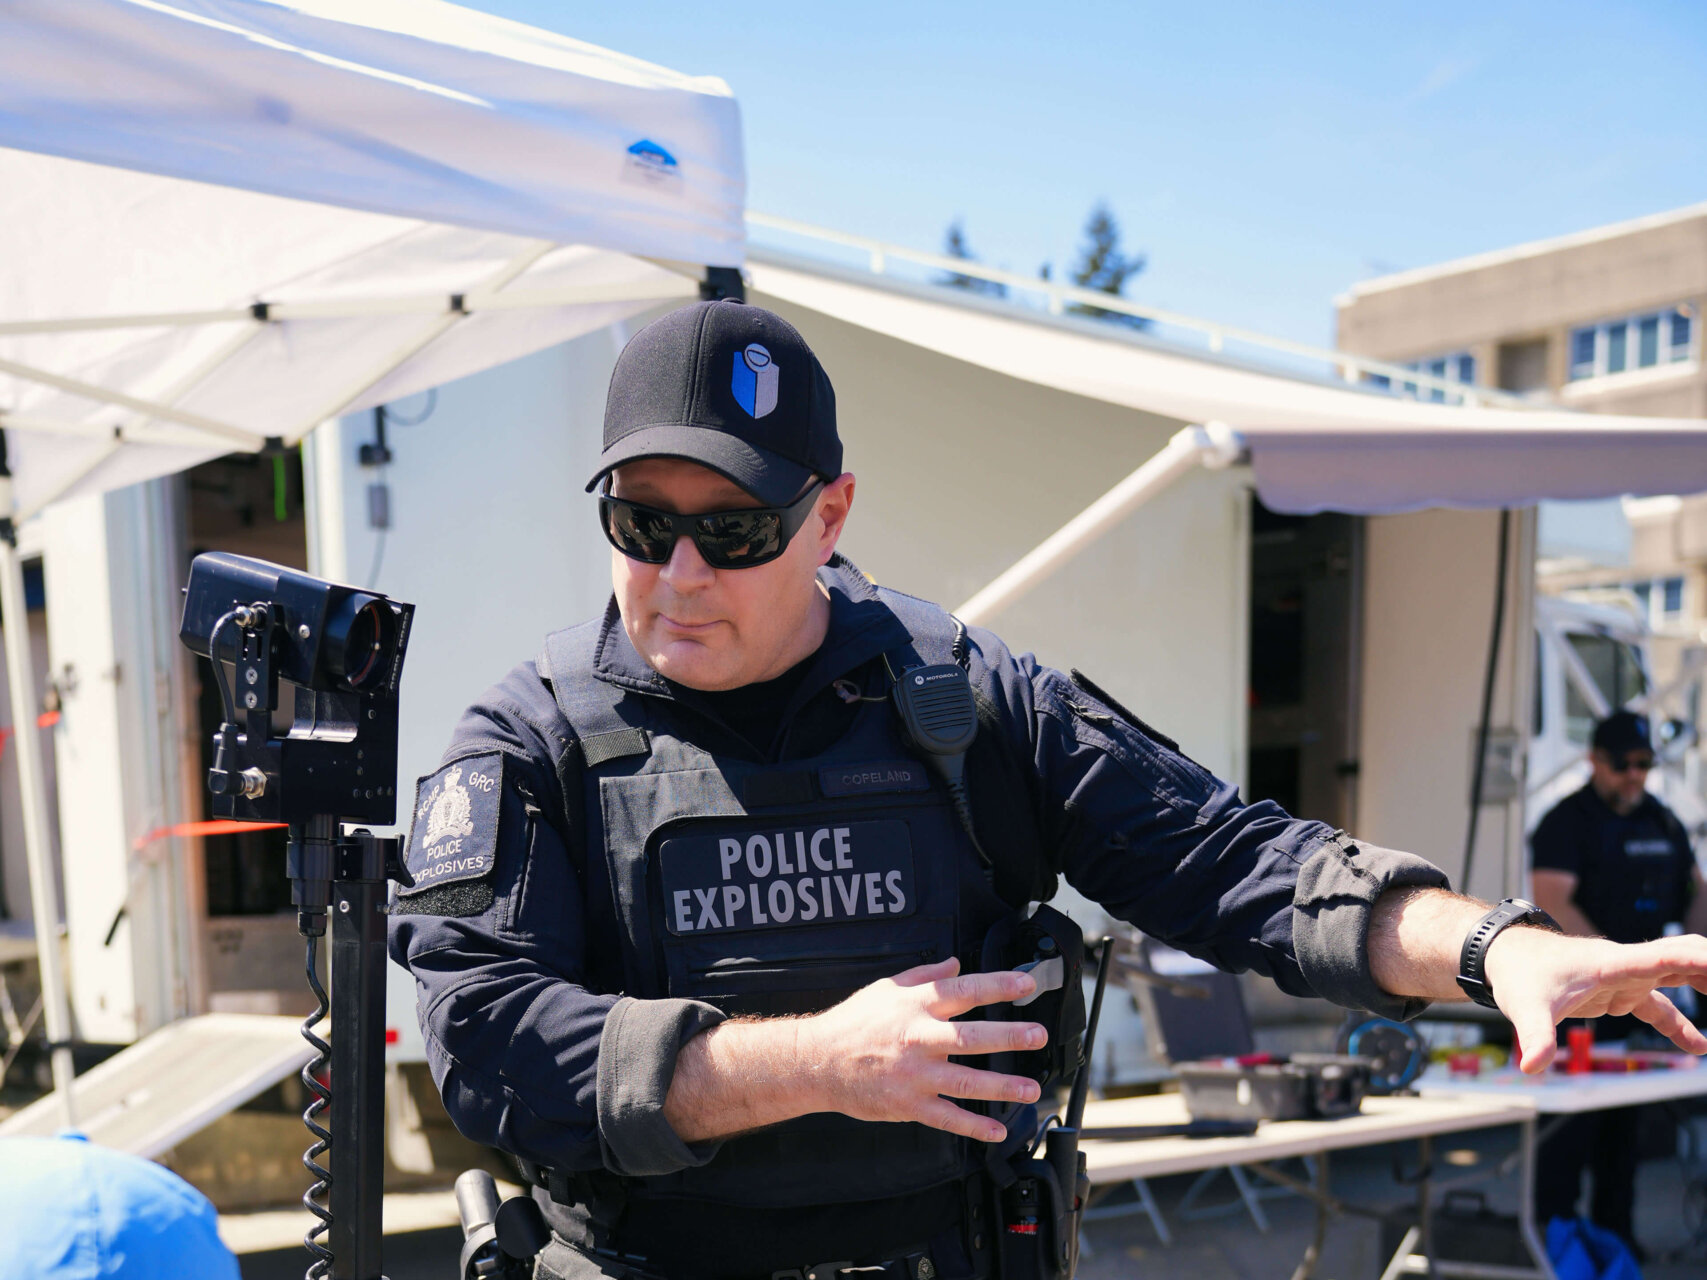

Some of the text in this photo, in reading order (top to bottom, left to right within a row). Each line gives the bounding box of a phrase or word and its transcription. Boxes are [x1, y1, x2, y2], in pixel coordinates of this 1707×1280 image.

[926, 672, 959, 681] MOTOROLA
[468, 771, 495, 793] GRC
[841, 769, 911, 786] COPELAND
[417, 784, 440, 820] RCMP
[426, 838, 463, 863] POLICE
[718, 826, 854, 881] POLICE
[672, 869, 907, 932] EXPLOSIVES
